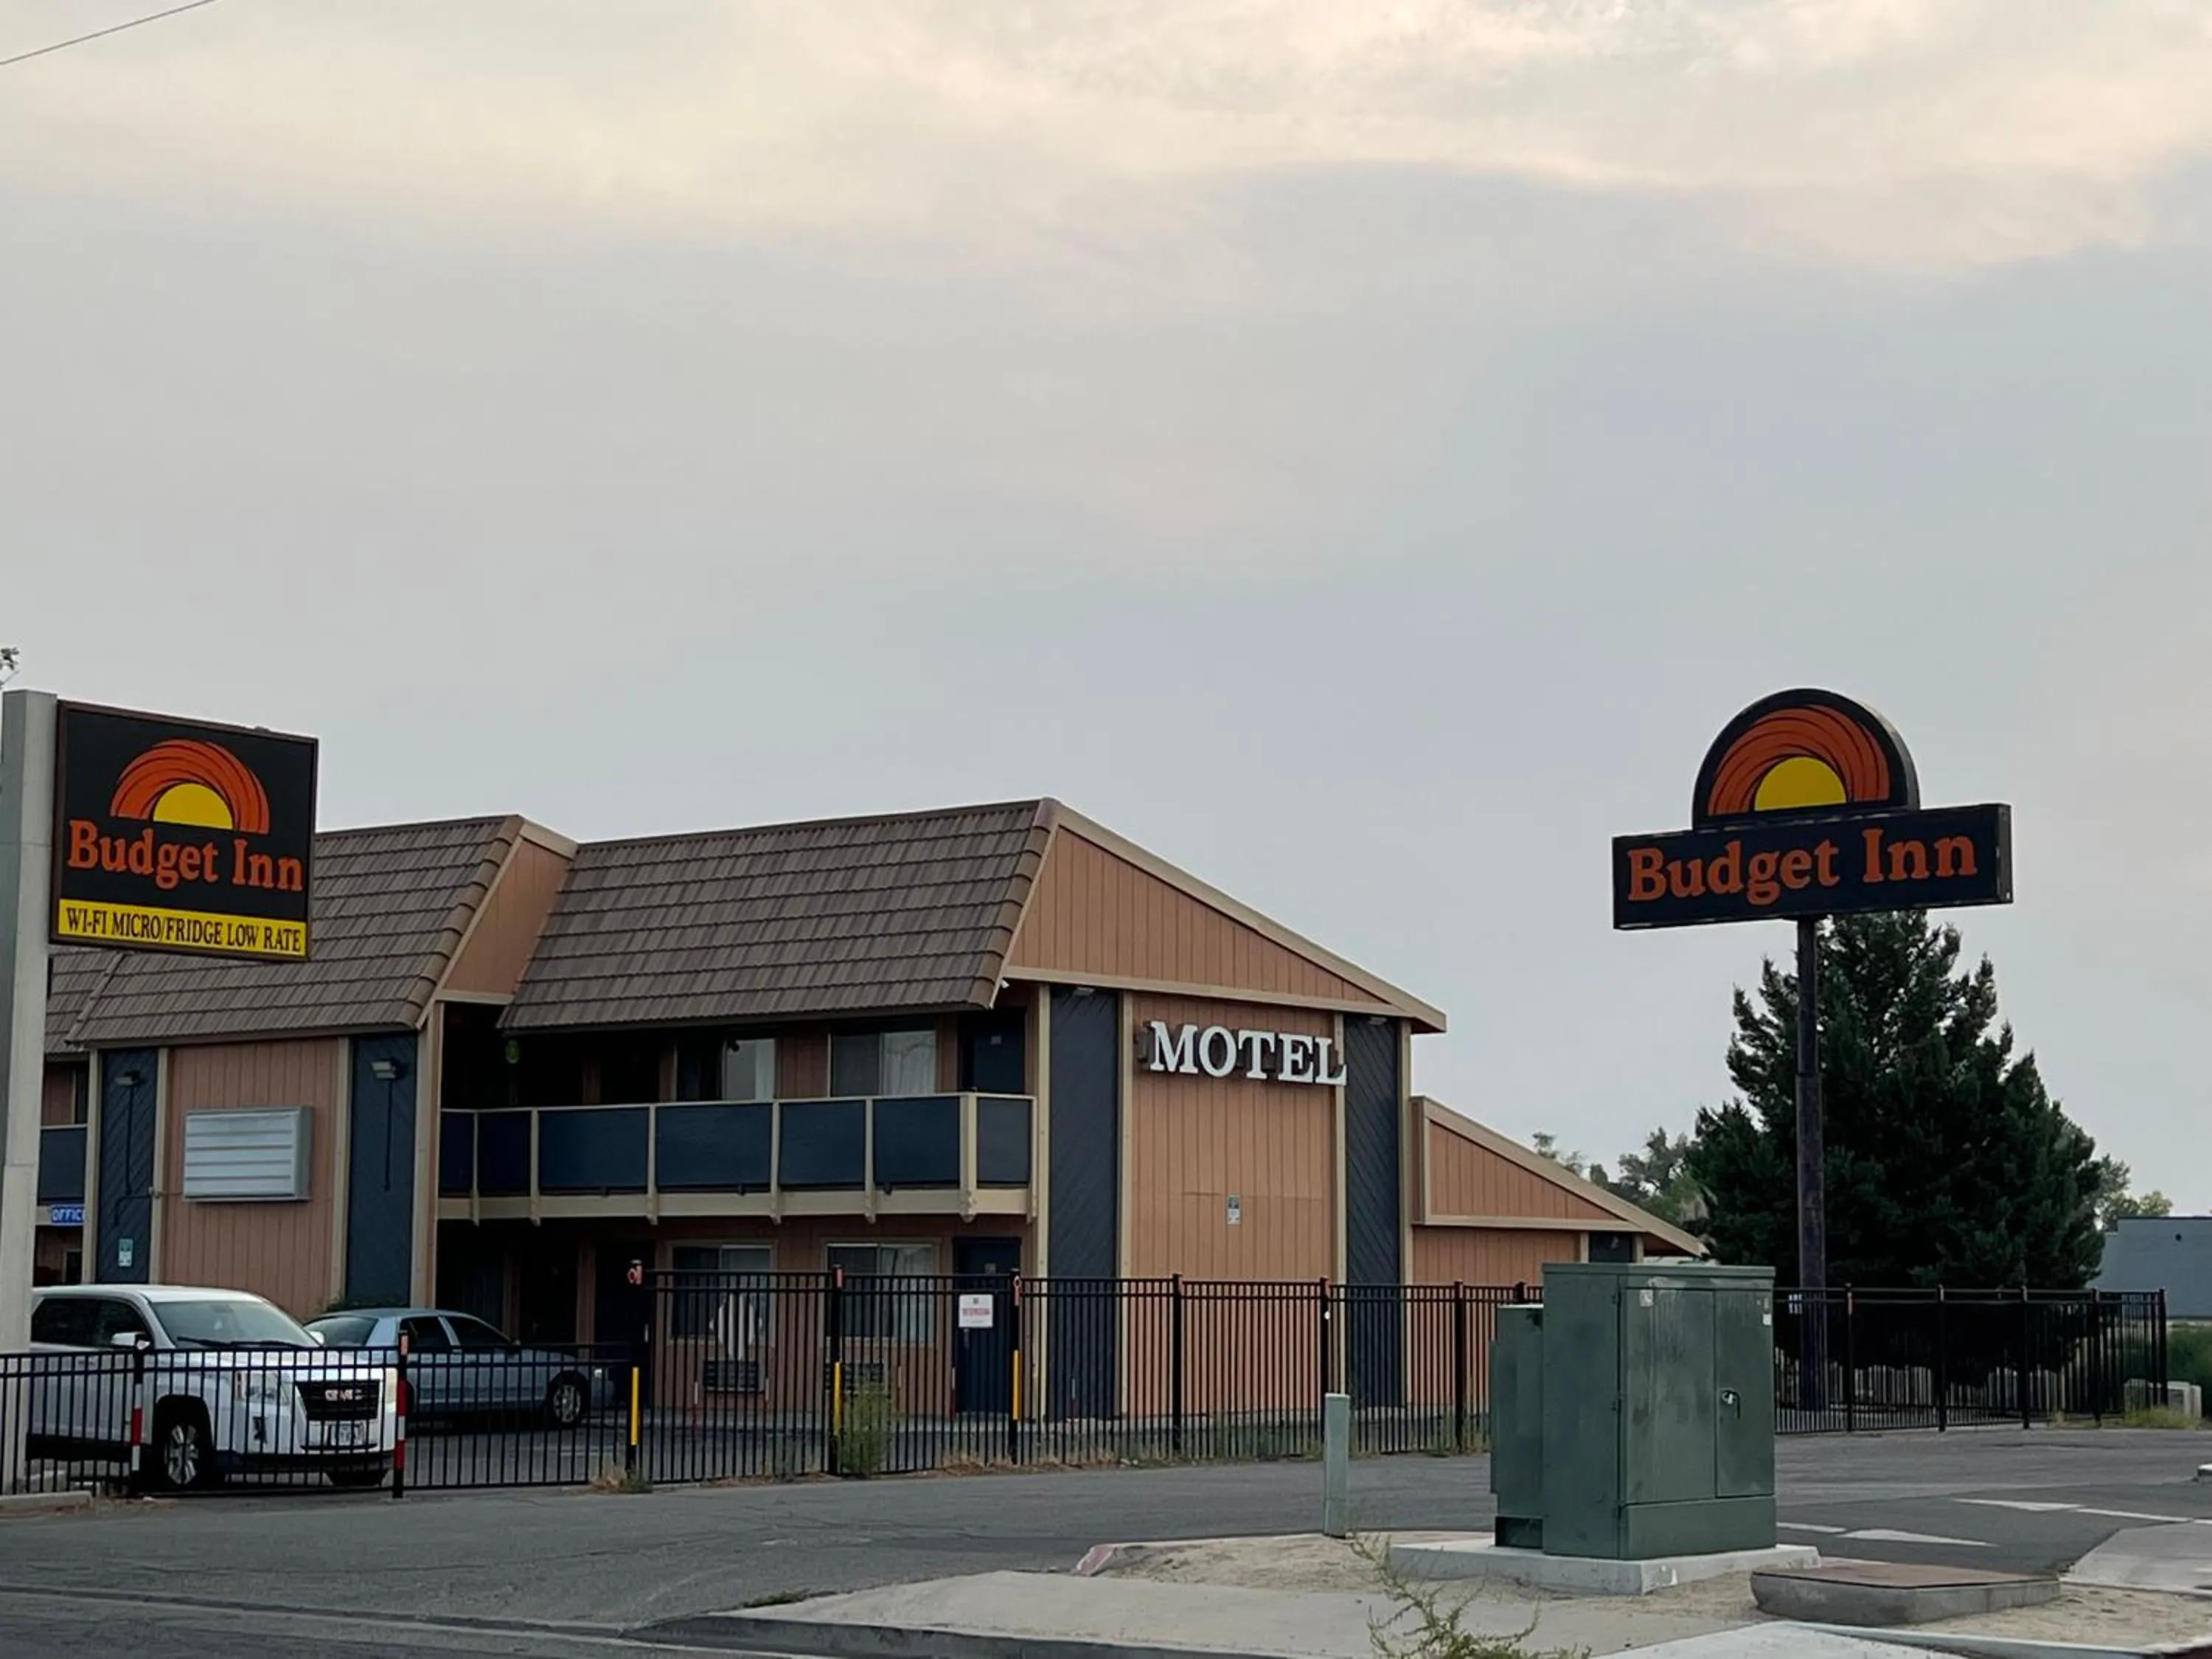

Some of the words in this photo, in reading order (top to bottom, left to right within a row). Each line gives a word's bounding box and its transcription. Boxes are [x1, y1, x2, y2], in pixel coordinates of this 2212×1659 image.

[68, 819, 218, 889] Budget
[232, 838, 304, 891] Inn
[1627, 840, 1840, 905] Budget
[1863, 828, 1978, 883] Inn
[66, 907, 107, 934] WI-FI
[227, 922, 259, 947] LOW
[263, 926, 300, 952] RATE
[1150, 1020, 1347, 1086] MOTEL
[52, 1208, 85, 1221] OFFIC
